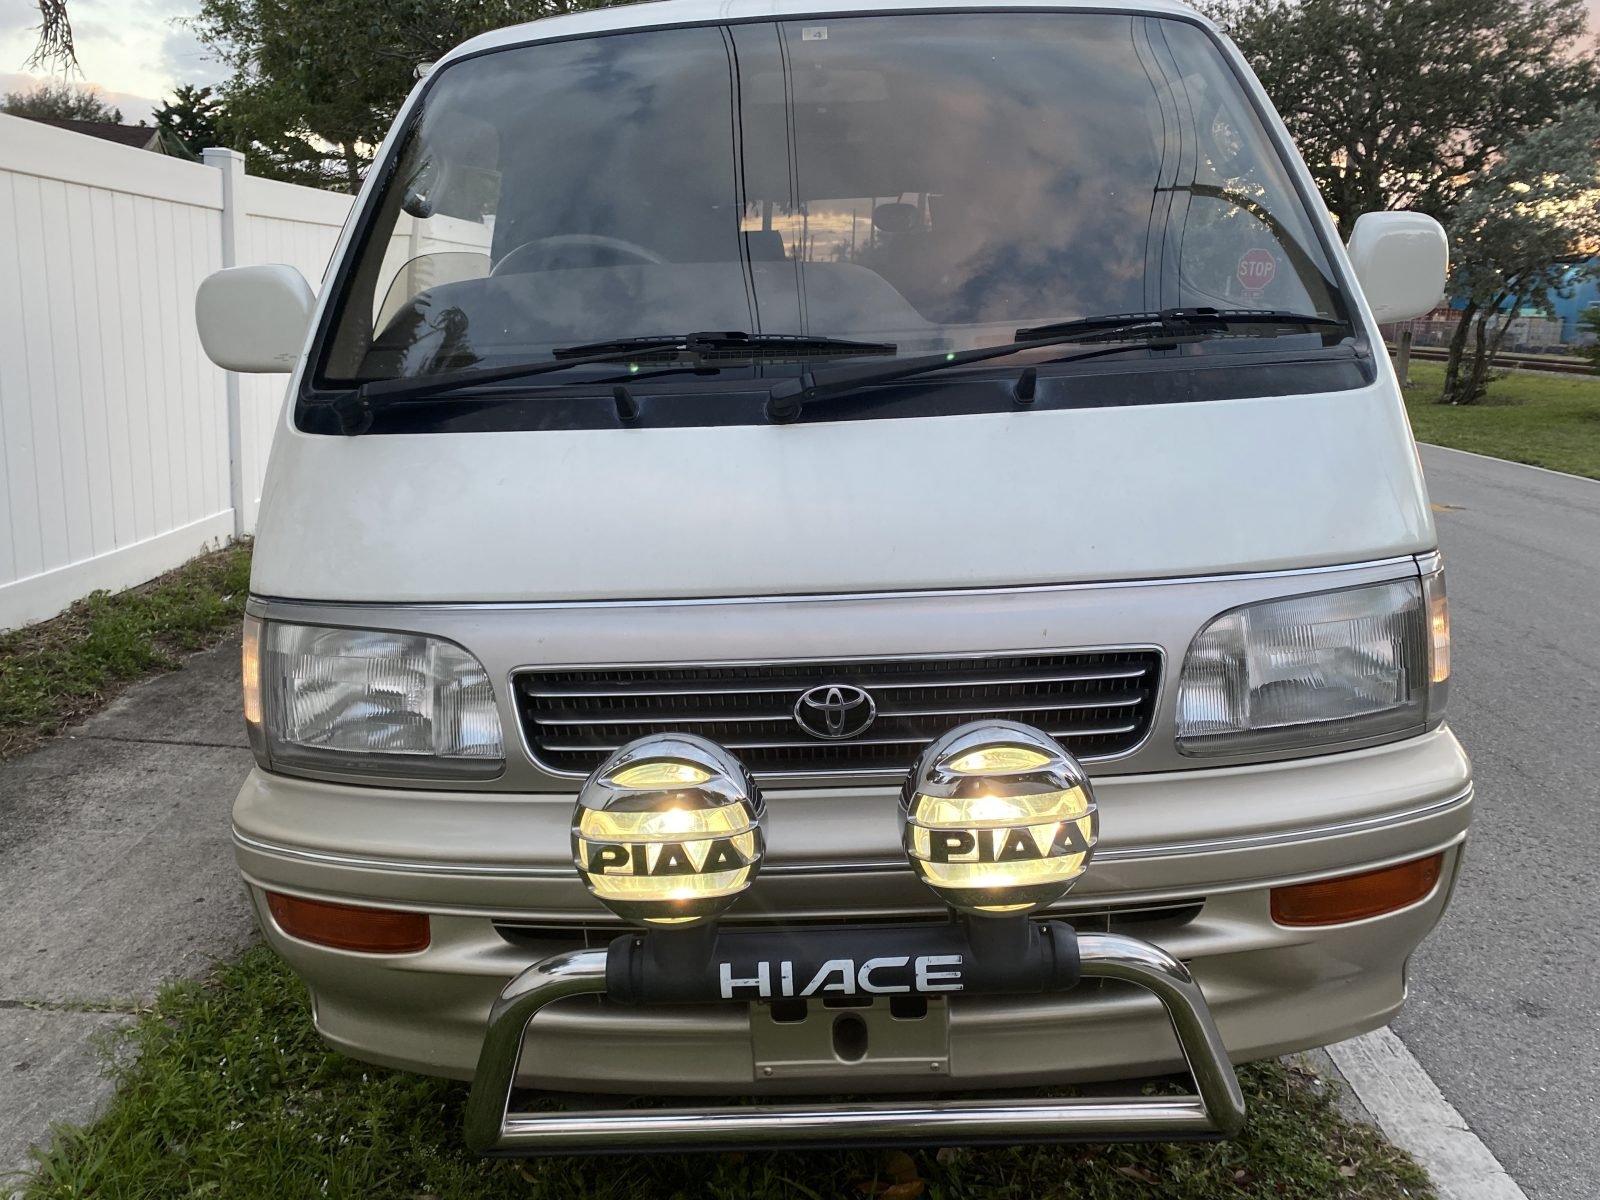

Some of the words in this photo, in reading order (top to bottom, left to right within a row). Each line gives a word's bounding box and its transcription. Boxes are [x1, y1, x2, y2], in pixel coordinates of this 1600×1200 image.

[1240, 261, 1273, 277] STOP
[588, 838, 744, 876] PIAA
[930, 821, 1090, 863] PIAA
[719, 955, 963, 998] HIACE
